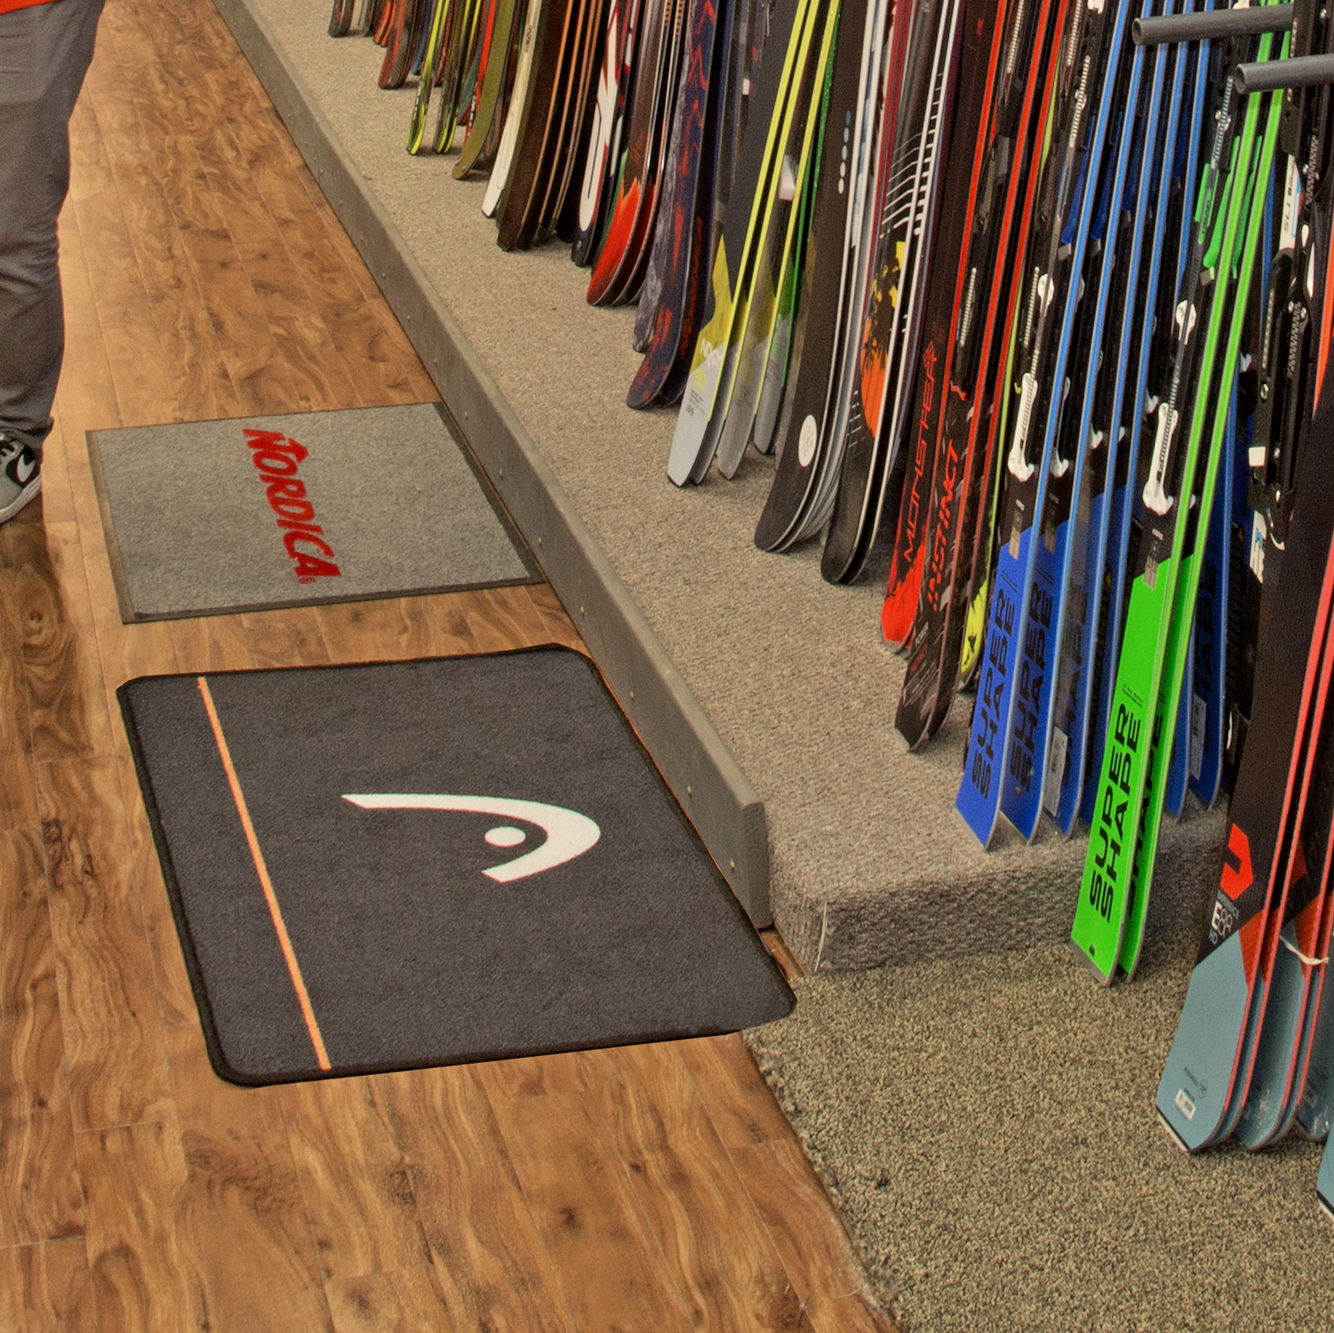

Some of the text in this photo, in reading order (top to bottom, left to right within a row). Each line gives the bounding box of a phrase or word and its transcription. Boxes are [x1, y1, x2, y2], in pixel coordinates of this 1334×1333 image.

[242, 429, 341, 578] NORDICA
[904, 341, 938, 562] MONSTER
[926, 438, 958, 612] INSTINCT
[971, 588, 1006, 790] SUPER
[976, 601, 1016, 800] SHAPE
[1009, 582, 1042, 778] SUPER
[1017, 589, 1053, 793] SHAPE
[1089, 702, 1130, 911] SUPER
[1098, 718, 1142, 923] SHAPE
